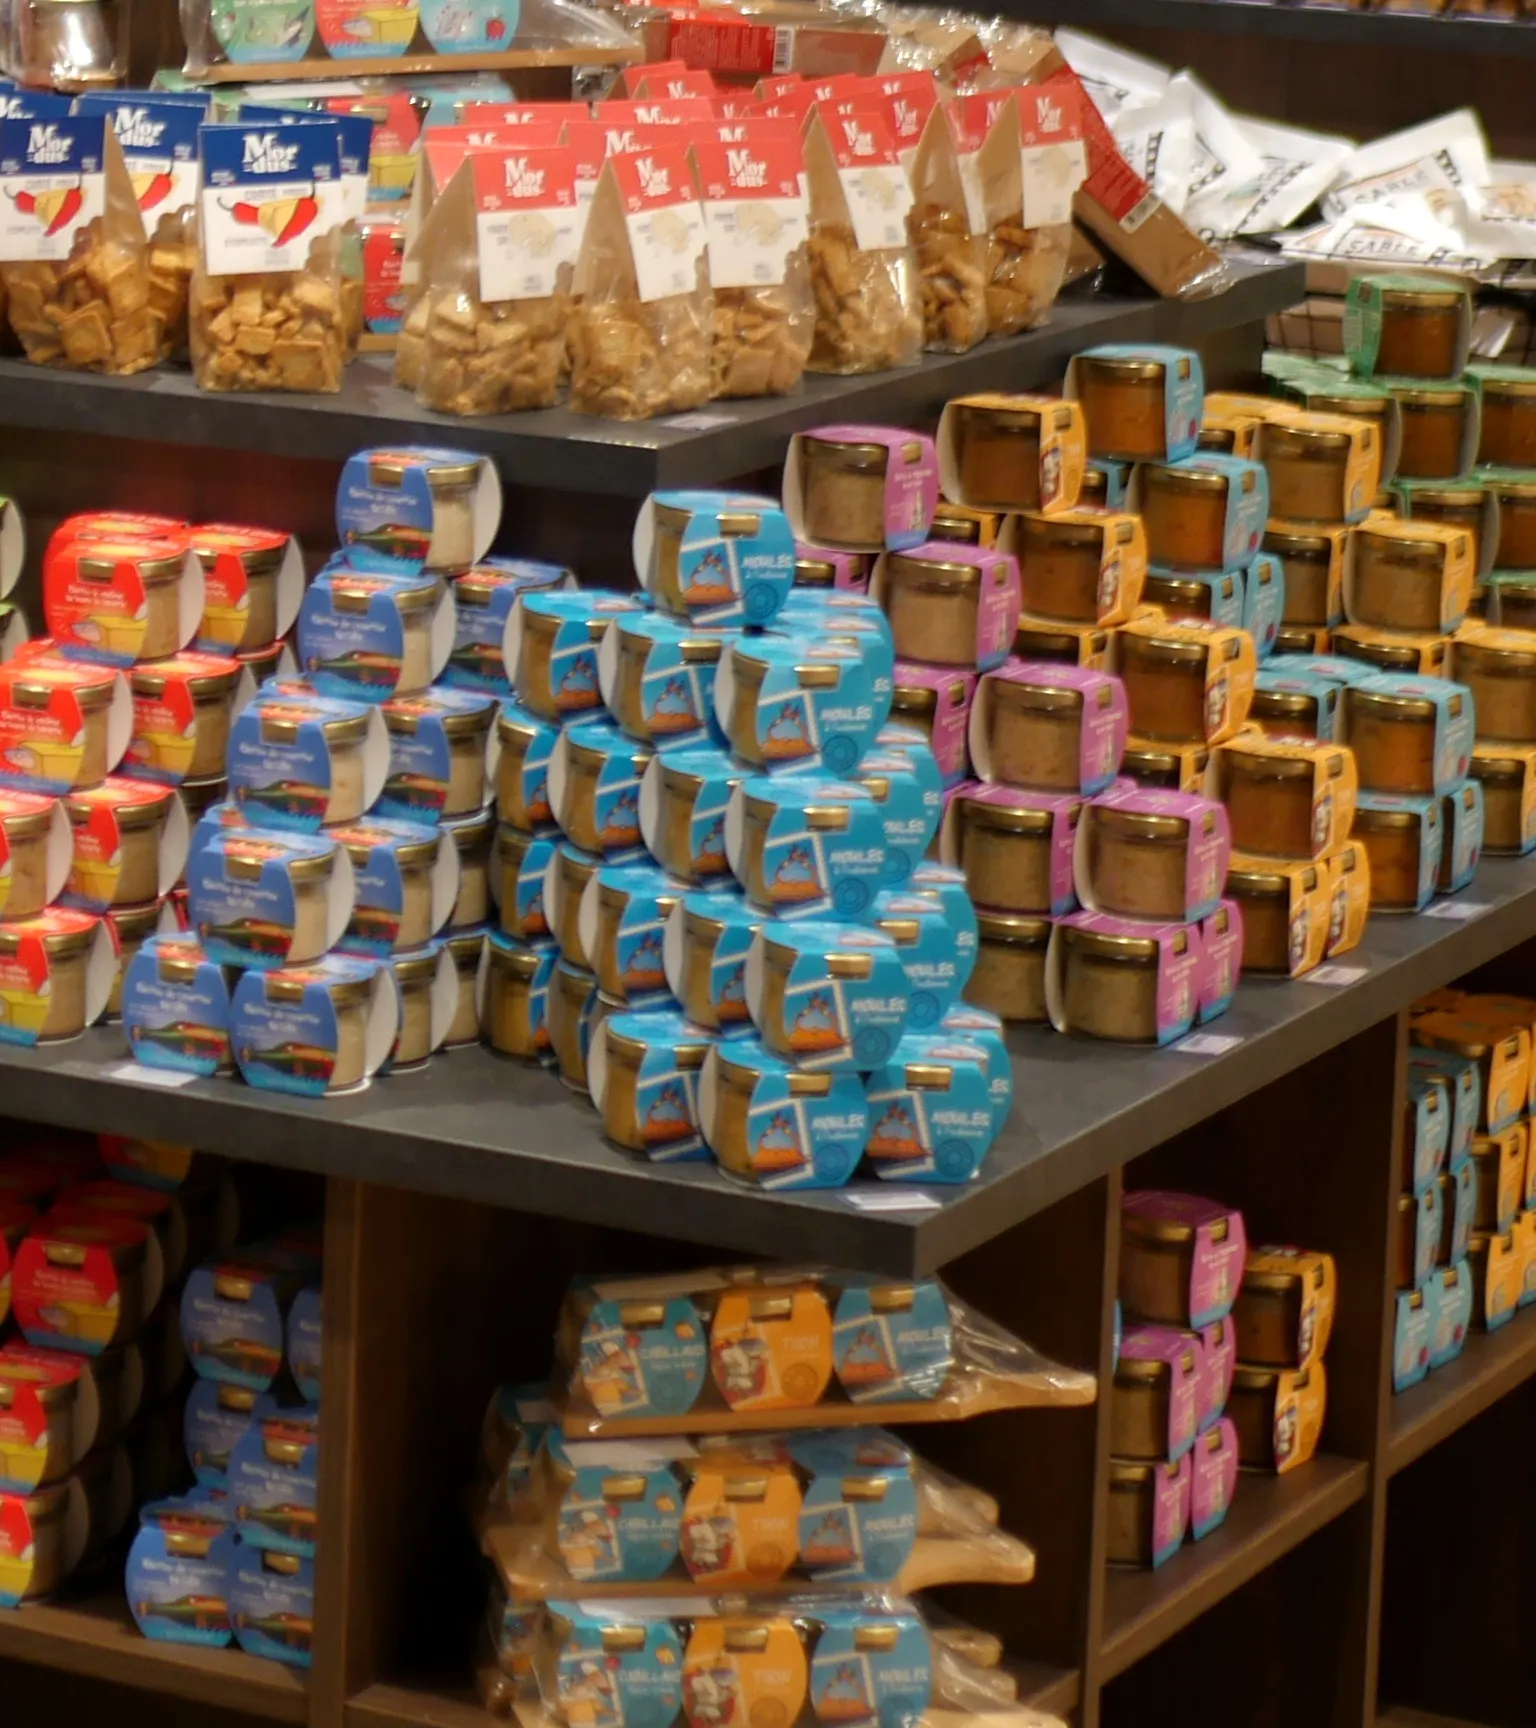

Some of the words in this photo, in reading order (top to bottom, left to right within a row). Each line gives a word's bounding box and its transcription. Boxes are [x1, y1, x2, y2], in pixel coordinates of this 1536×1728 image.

[114, 107, 167, 136] Mor
[29, 125, 75, 155] Mor
[242, 133, 301, 164] Mor
[504, 158, 545, 186] Mor
[726, 149, 767, 177] Mor
